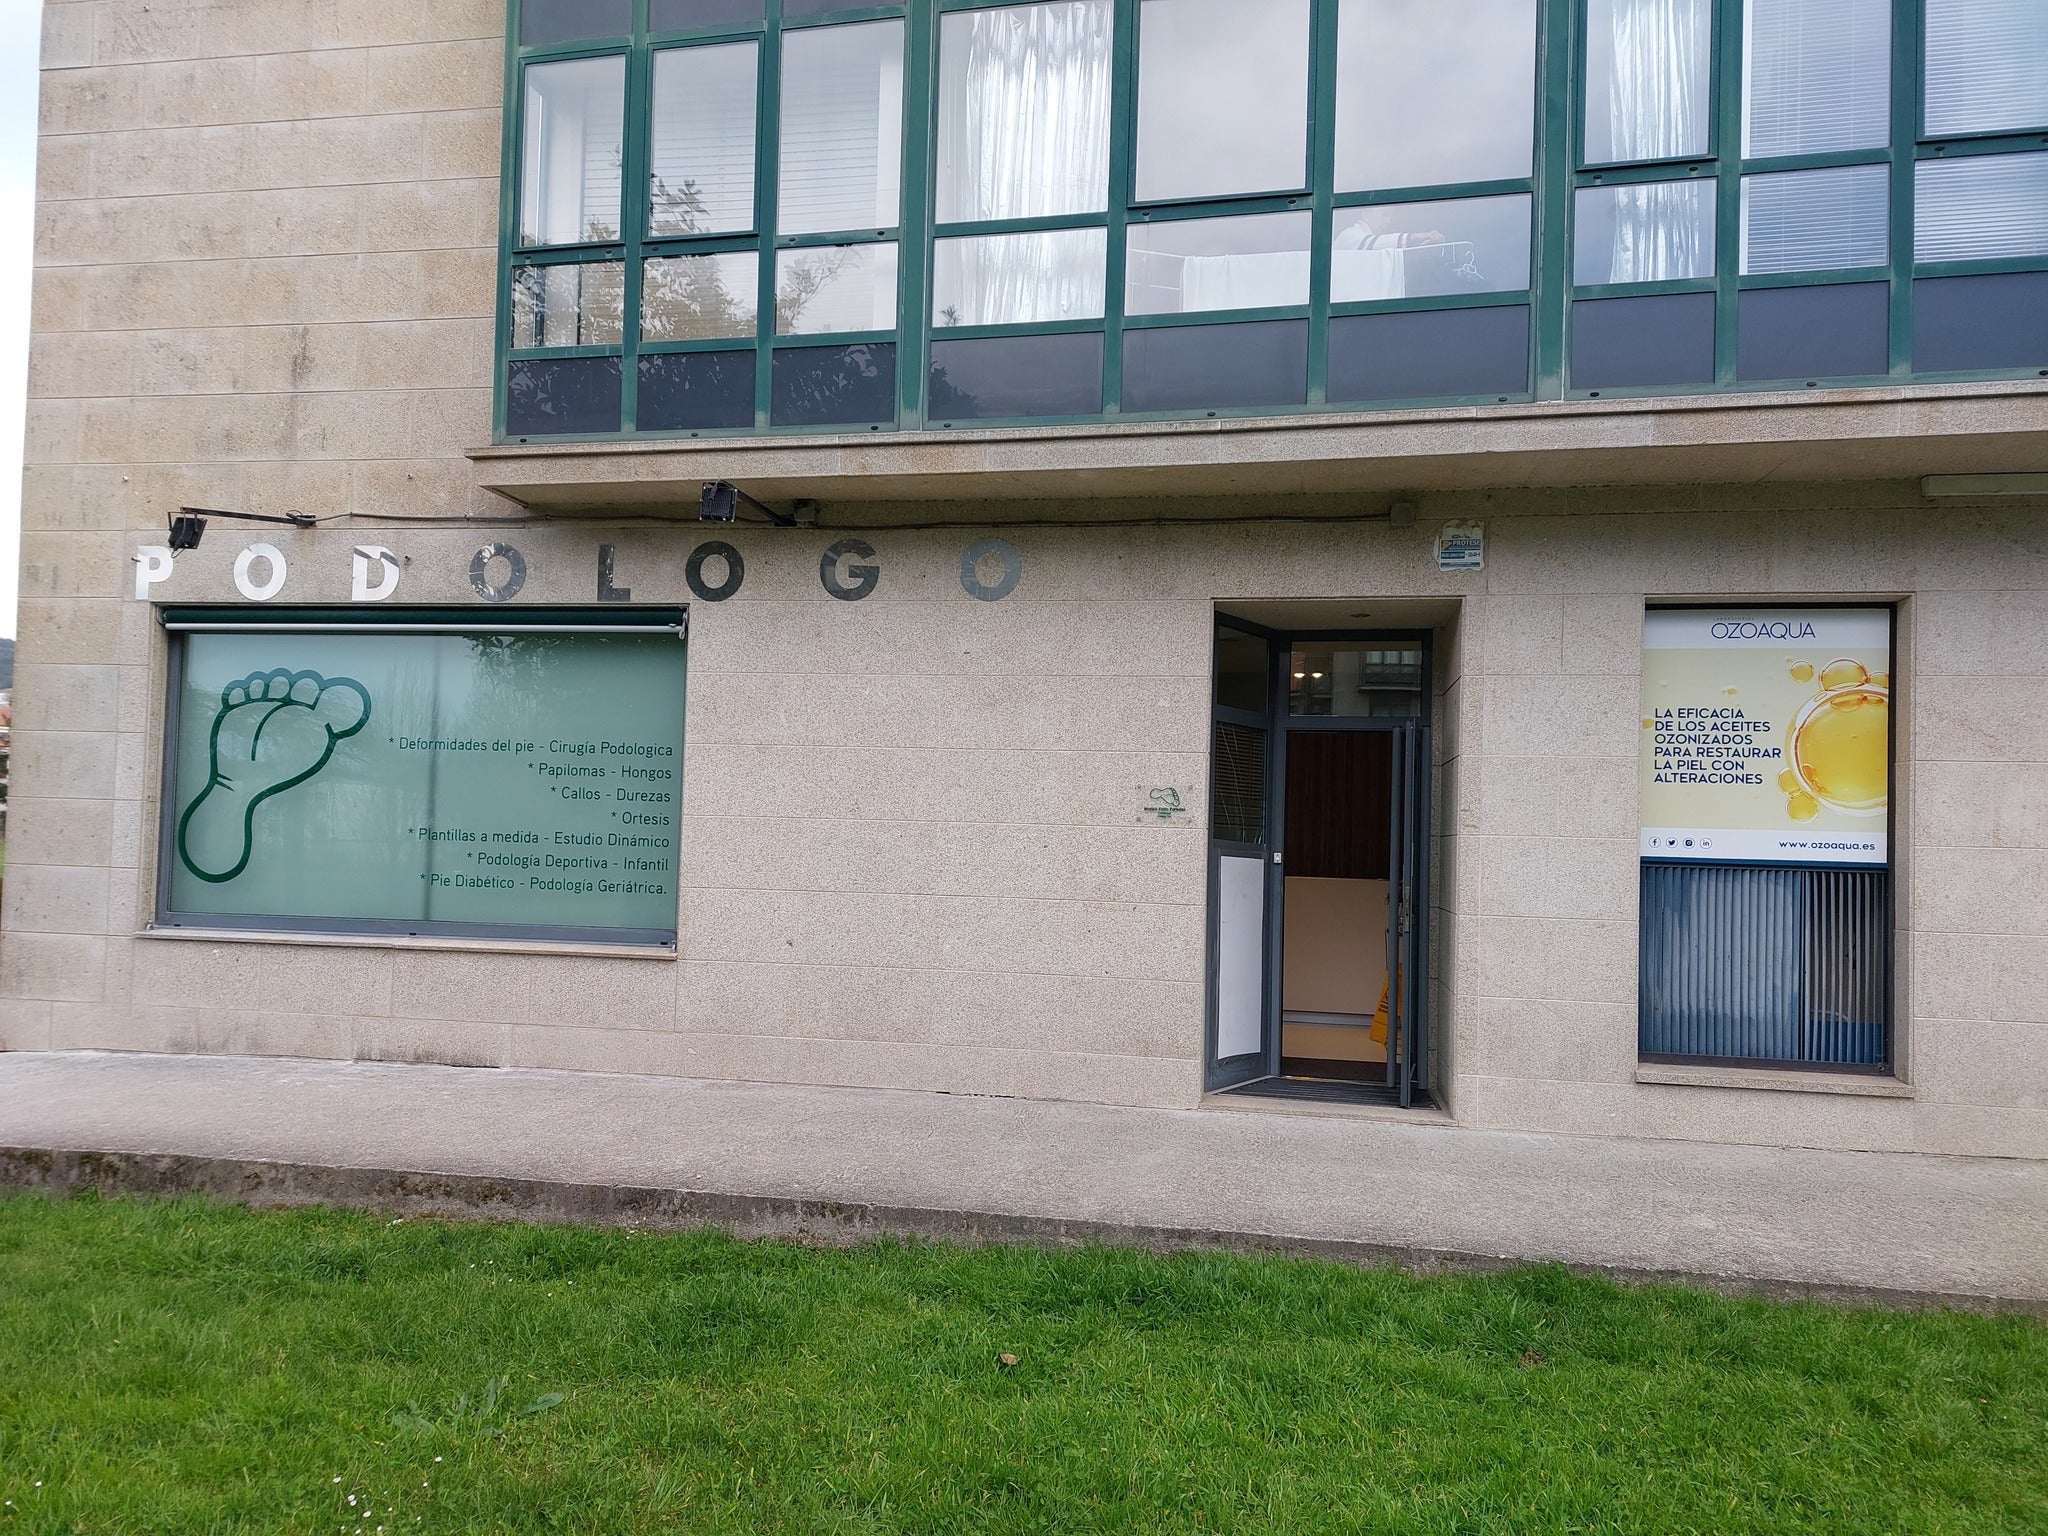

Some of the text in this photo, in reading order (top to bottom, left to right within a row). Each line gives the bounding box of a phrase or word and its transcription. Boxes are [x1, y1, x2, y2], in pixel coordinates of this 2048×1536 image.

[135, 538, 1023, 602] PODOLOGO
[1711, 622, 1816, 640] OZOAQUA
[1655, 708, 1744, 719] LA EFICACIA
[1655, 721, 1771, 732] DE LOS ACEITES
[1654, 733, 1753, 745] OZONIZADOS
[399, 736, 488, 751] Deformidades
[491, 738, 511, 751] del
[515, 739, 534, 755] pie
[549, 740, 596, 756] Cirugía
[600, 741, 673, 758] Podologica
[1654, 747, 1782, 758] PARA RESTAURAR
[538, 763, 606, 779] Papilomas
[621, 765, 672, 781] Hongos
[1654, 760, 1744, 770] LA PIEL CON
[1654, 773, 1763, 784] ALTERACIONES
[561, 786, 601, 800] Callos
[616, 788, 671, 802] Durezas
[622, 811, 670, 825] Ortesis
[418, 828, 476, 841] Plantillas
[480, 832, 488, 842] a
[492, 830, 539, 843] medida
[554, 831, 603, 845] Estudio
[608, 833, 670, 847] Dinámico
[1779, 841, 1876, 851] www.ozoaqua.es
[477, 852, 540, 869] Podología
[545, 854, 608, 871] Deportiva
[623, 857, 669, 871] Infantil
[430, 874, 451, 887] Pie
[455, 874, 515, 889] Diabético
[530, 876, 593, 894] Podología
[598, 879, 667, 895] Geriátrica.
